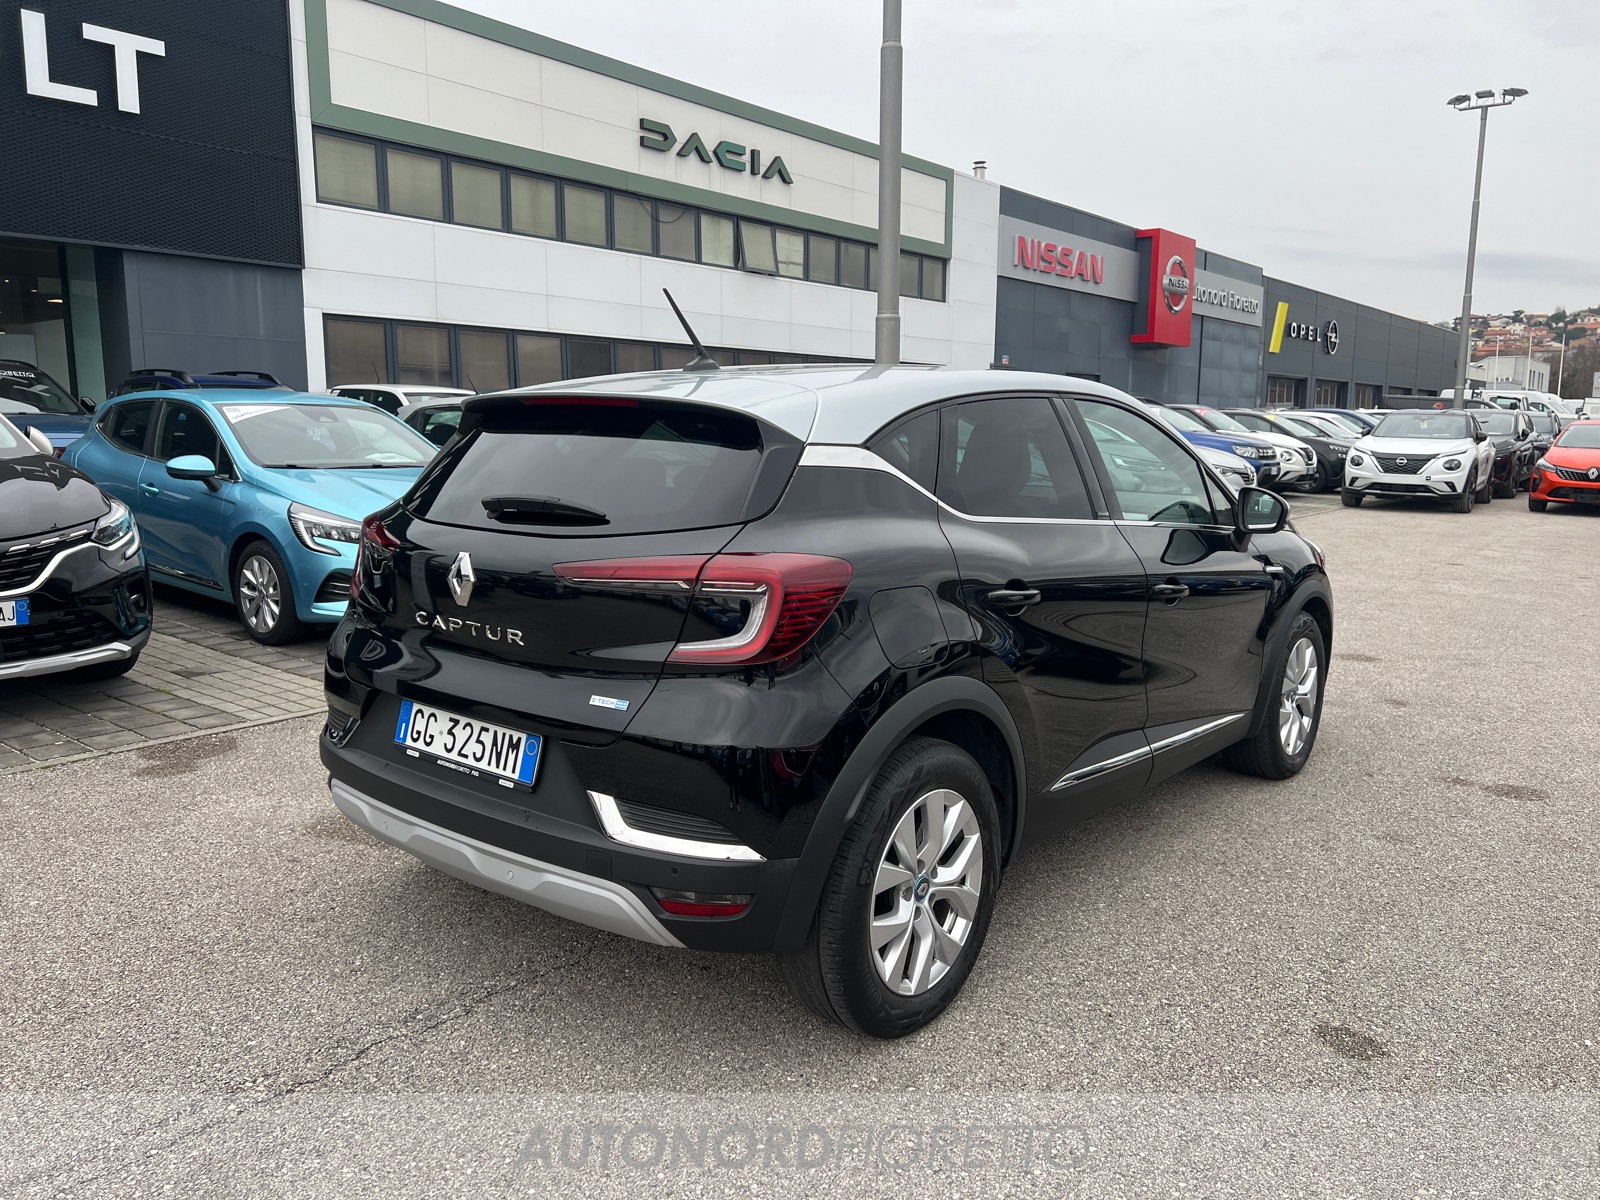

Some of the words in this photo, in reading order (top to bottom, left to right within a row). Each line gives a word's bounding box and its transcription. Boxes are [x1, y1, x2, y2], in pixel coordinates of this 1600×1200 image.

[639, 117, 794, 184] DACIA
[1014, 234, 1104, 285] NISSAN
[1168, 277, 1188, 290] NISSA
[1192, 283, 1227, 307] utonord
[1229, 290, 1260, 314] Fioretto
[1290, 322, 1321, 342] OPEL
[415, 610, 525, 646] CAPTUR
